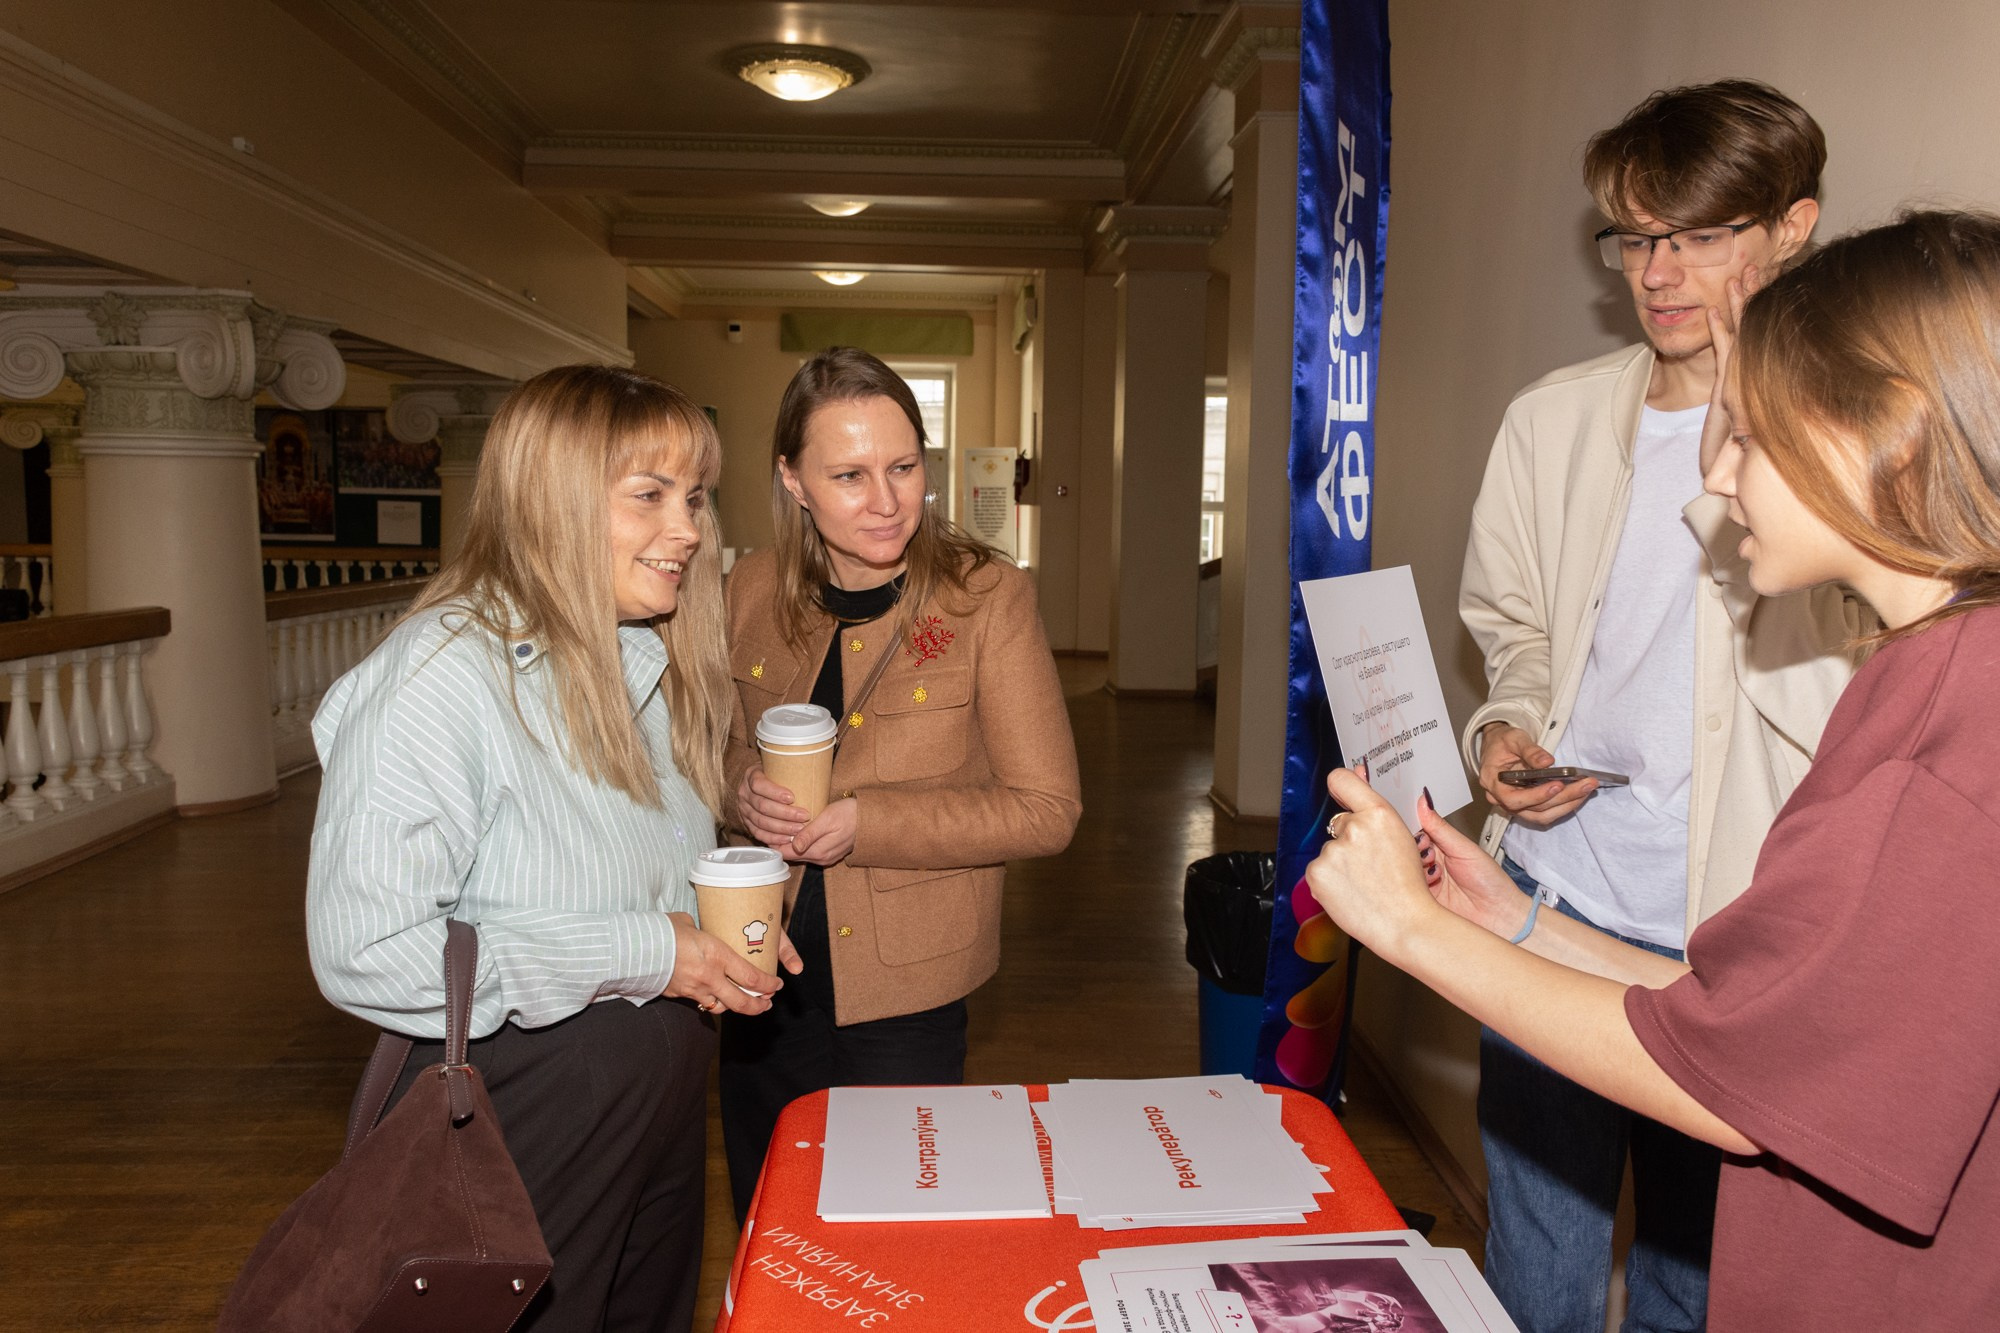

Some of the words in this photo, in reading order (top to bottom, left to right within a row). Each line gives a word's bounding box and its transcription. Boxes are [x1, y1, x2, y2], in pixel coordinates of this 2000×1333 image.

[1340, 134, 1370, 541] ФЕСТ
[1394, 730, 1412, 747] трубах
[1412, 727, 1419, 736] от
[1420, 719, 1438, 734] плохо
[1400, 748, 1414, 763] воды
[750, 1254, 889, 1328] ЗАРЯЖЕН
[761, 1226, 924, 1309] ЗНАНИЯМИ
[1116, 1300, 1129, 1320] РОБЕРТ
[1123, 1321, 1133, 1333] ЗЕМ
